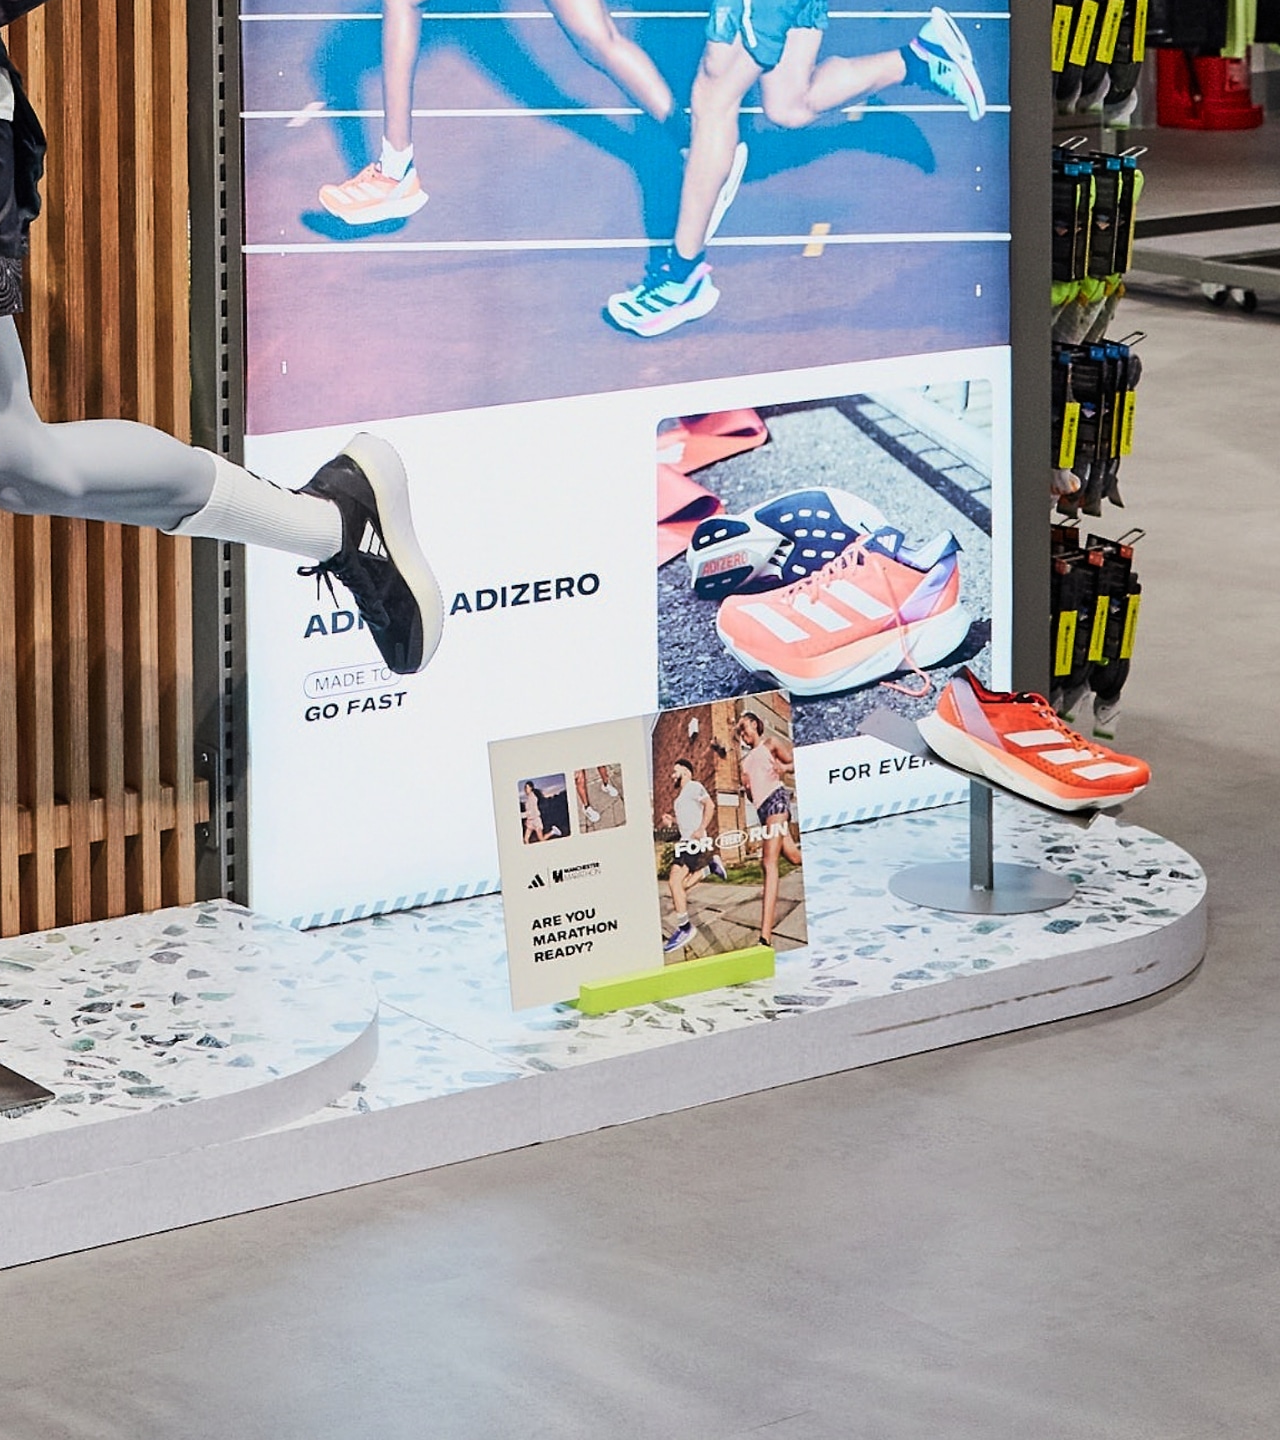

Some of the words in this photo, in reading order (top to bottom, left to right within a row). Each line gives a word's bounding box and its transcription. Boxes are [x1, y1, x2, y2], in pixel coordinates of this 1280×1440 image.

[449, 572, 601, 616] ADIZERO
[314, 670, 365, 692] MADE
[371, 666, 393, 684] TO
[304, 702, 340, 723] GO
[346, 691, 408, 717] FAST
[828, 763, 871, 784] FOR
[879, 754, 934, 776] EVE
[674, 836, 714, 858] FOR
[749, 821, 788, 842] RUN
[532, 915, 562, 931] ARE
[566, 908, 596, 923] YOU
[533, 919, 618, 947] MARATHON
[534, 941, 594, 963] READY?
